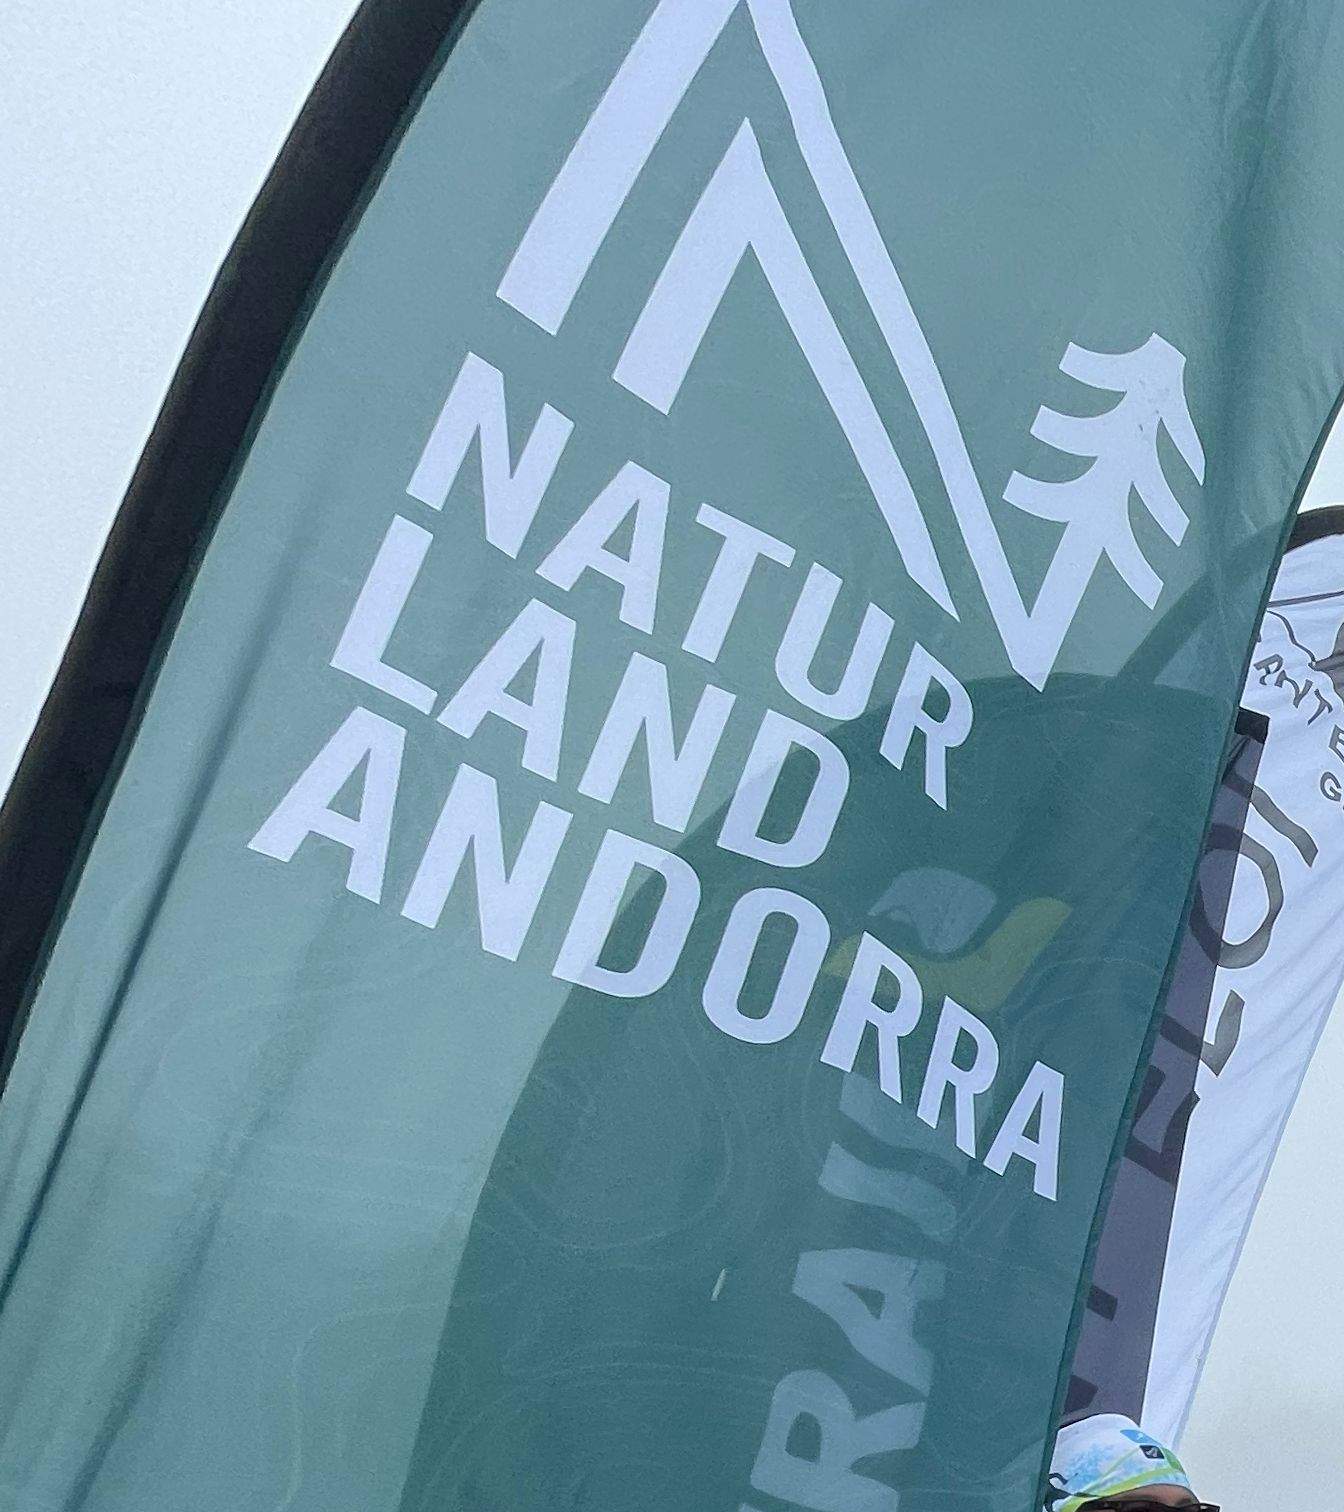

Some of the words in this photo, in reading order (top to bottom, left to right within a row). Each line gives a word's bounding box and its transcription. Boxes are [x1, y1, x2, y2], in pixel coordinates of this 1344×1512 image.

[328, 514, 851, 870] LAND
[404, 350, 975, 811] NATUR
[247, 704, 1066, 1201] ANDORRA
